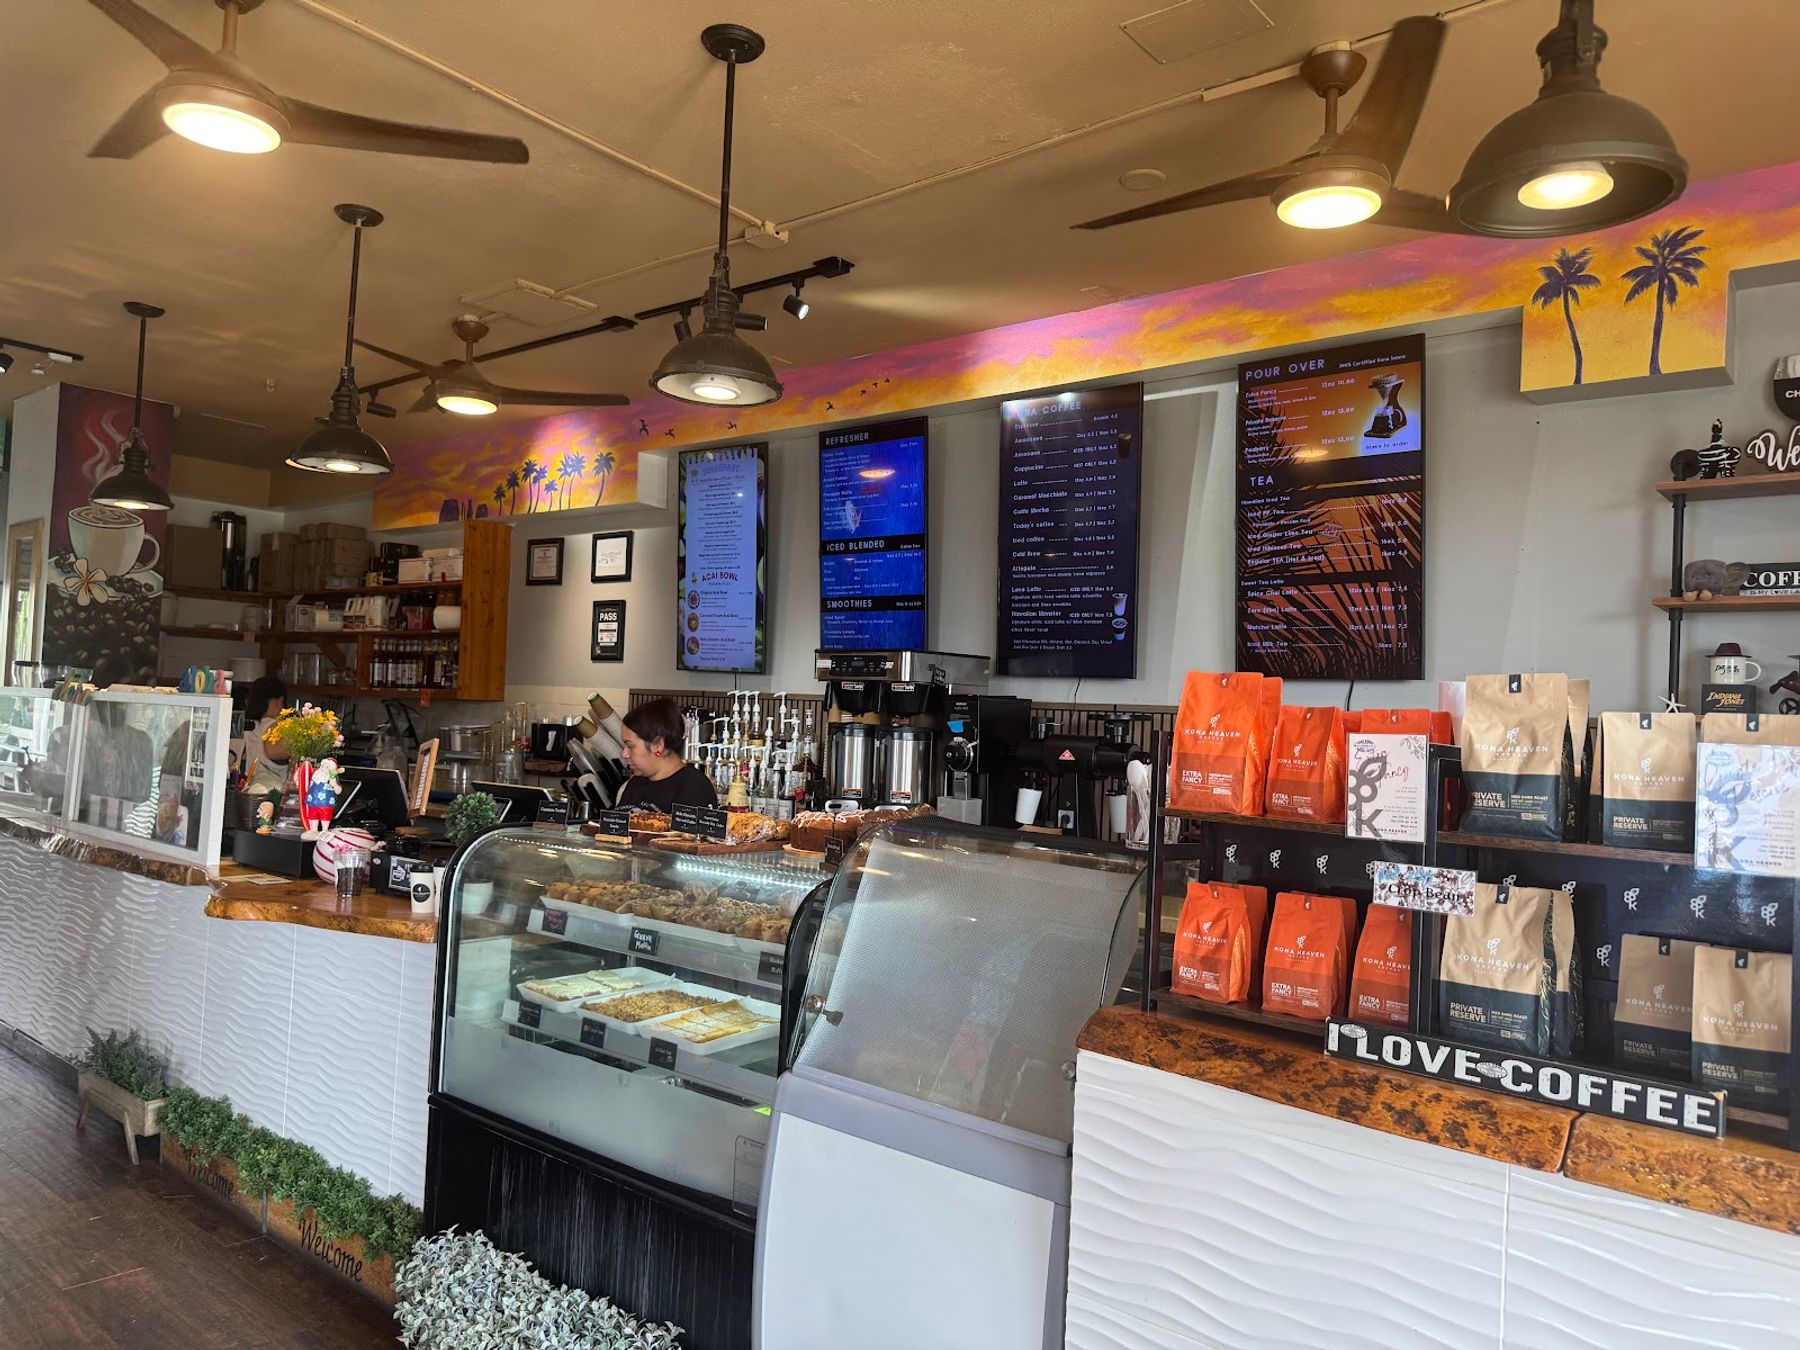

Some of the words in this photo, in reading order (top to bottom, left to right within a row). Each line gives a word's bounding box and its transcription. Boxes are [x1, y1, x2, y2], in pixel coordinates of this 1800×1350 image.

[1245, 366, 1280, 380] POUR
[1288, 359, 1325, 373] OVER
[1261, 388, 1277, 397] Fancy
[1042, 401, 1081, 413] COFFEE
[825, 432, 869, 445] REFRESHER
[1250, 475, 1274, 487] TEA
[1013, 493, 1037, 501] Caramel
[1013, 521, 1034, 529] Today's
[849, 540, 885, 550] BLENDED
[702, 572, 718, 581] ACAI
[720, 572, 738, 581] BOWL
[827, 600, 872, 608] SMOOTHIES
[600, 613, 617, 621] PASS
[1706, 691, 1741, 701] INDIANA
[1716, 699, 1745, 707] JONES
[1185, 729, 1207, 737] KONA
[1209, 730, 1241, 738] HEAVEN
[1475, 743, 1504, 752] KONA
[1614, 774, 1640, 782] KONA
[1644, 775, 1684, 783] HEAVEN
[1613, 816, 1644, 824] PRIVATE
[1613, 822, 1647, 831] RESERVE
[1388, 884, 1421, 898] Crop
[1273, 946, 1295, 954] KONA
[1296, 948, 1325, 958] HEAVEN
[1363, 957, 1384, 966] KONA
[1456, 952, 1483, 962] KONA
[1488, 958, 1529, 971] HEAVEN
[1272, 982, 1291, 990] EXTRA
[1359, 994, 1380, 1004] EXTRA
[1625, 998, 1651, 1007] KONA
[1359, 1000, 1381, 1009] FANCY
[1450, 1002, 1483, 1015] PRIVATE
[1450, 1010, 1486, 1023] RESERVE
[1703, 1016, 1733, 1027] KONA
[1736, 1021, 1778, 1031] HEAVEN
[1624, 1039, 1652, 1050] PRIVATE
[1624, 1045, 1655, 1057] RESERVE
[1702, 1062, 1736, 1072] PRIVATE
[1327, 1022, 1340, 1052] I
[1355, 1034, 1481, 1084] LOVE
[1499, 1059, 1717, 1134] COFFEE
[1702, 1068, 1738, 1080] RESERVE
[299, 1218, 363, 1282] Welcome
